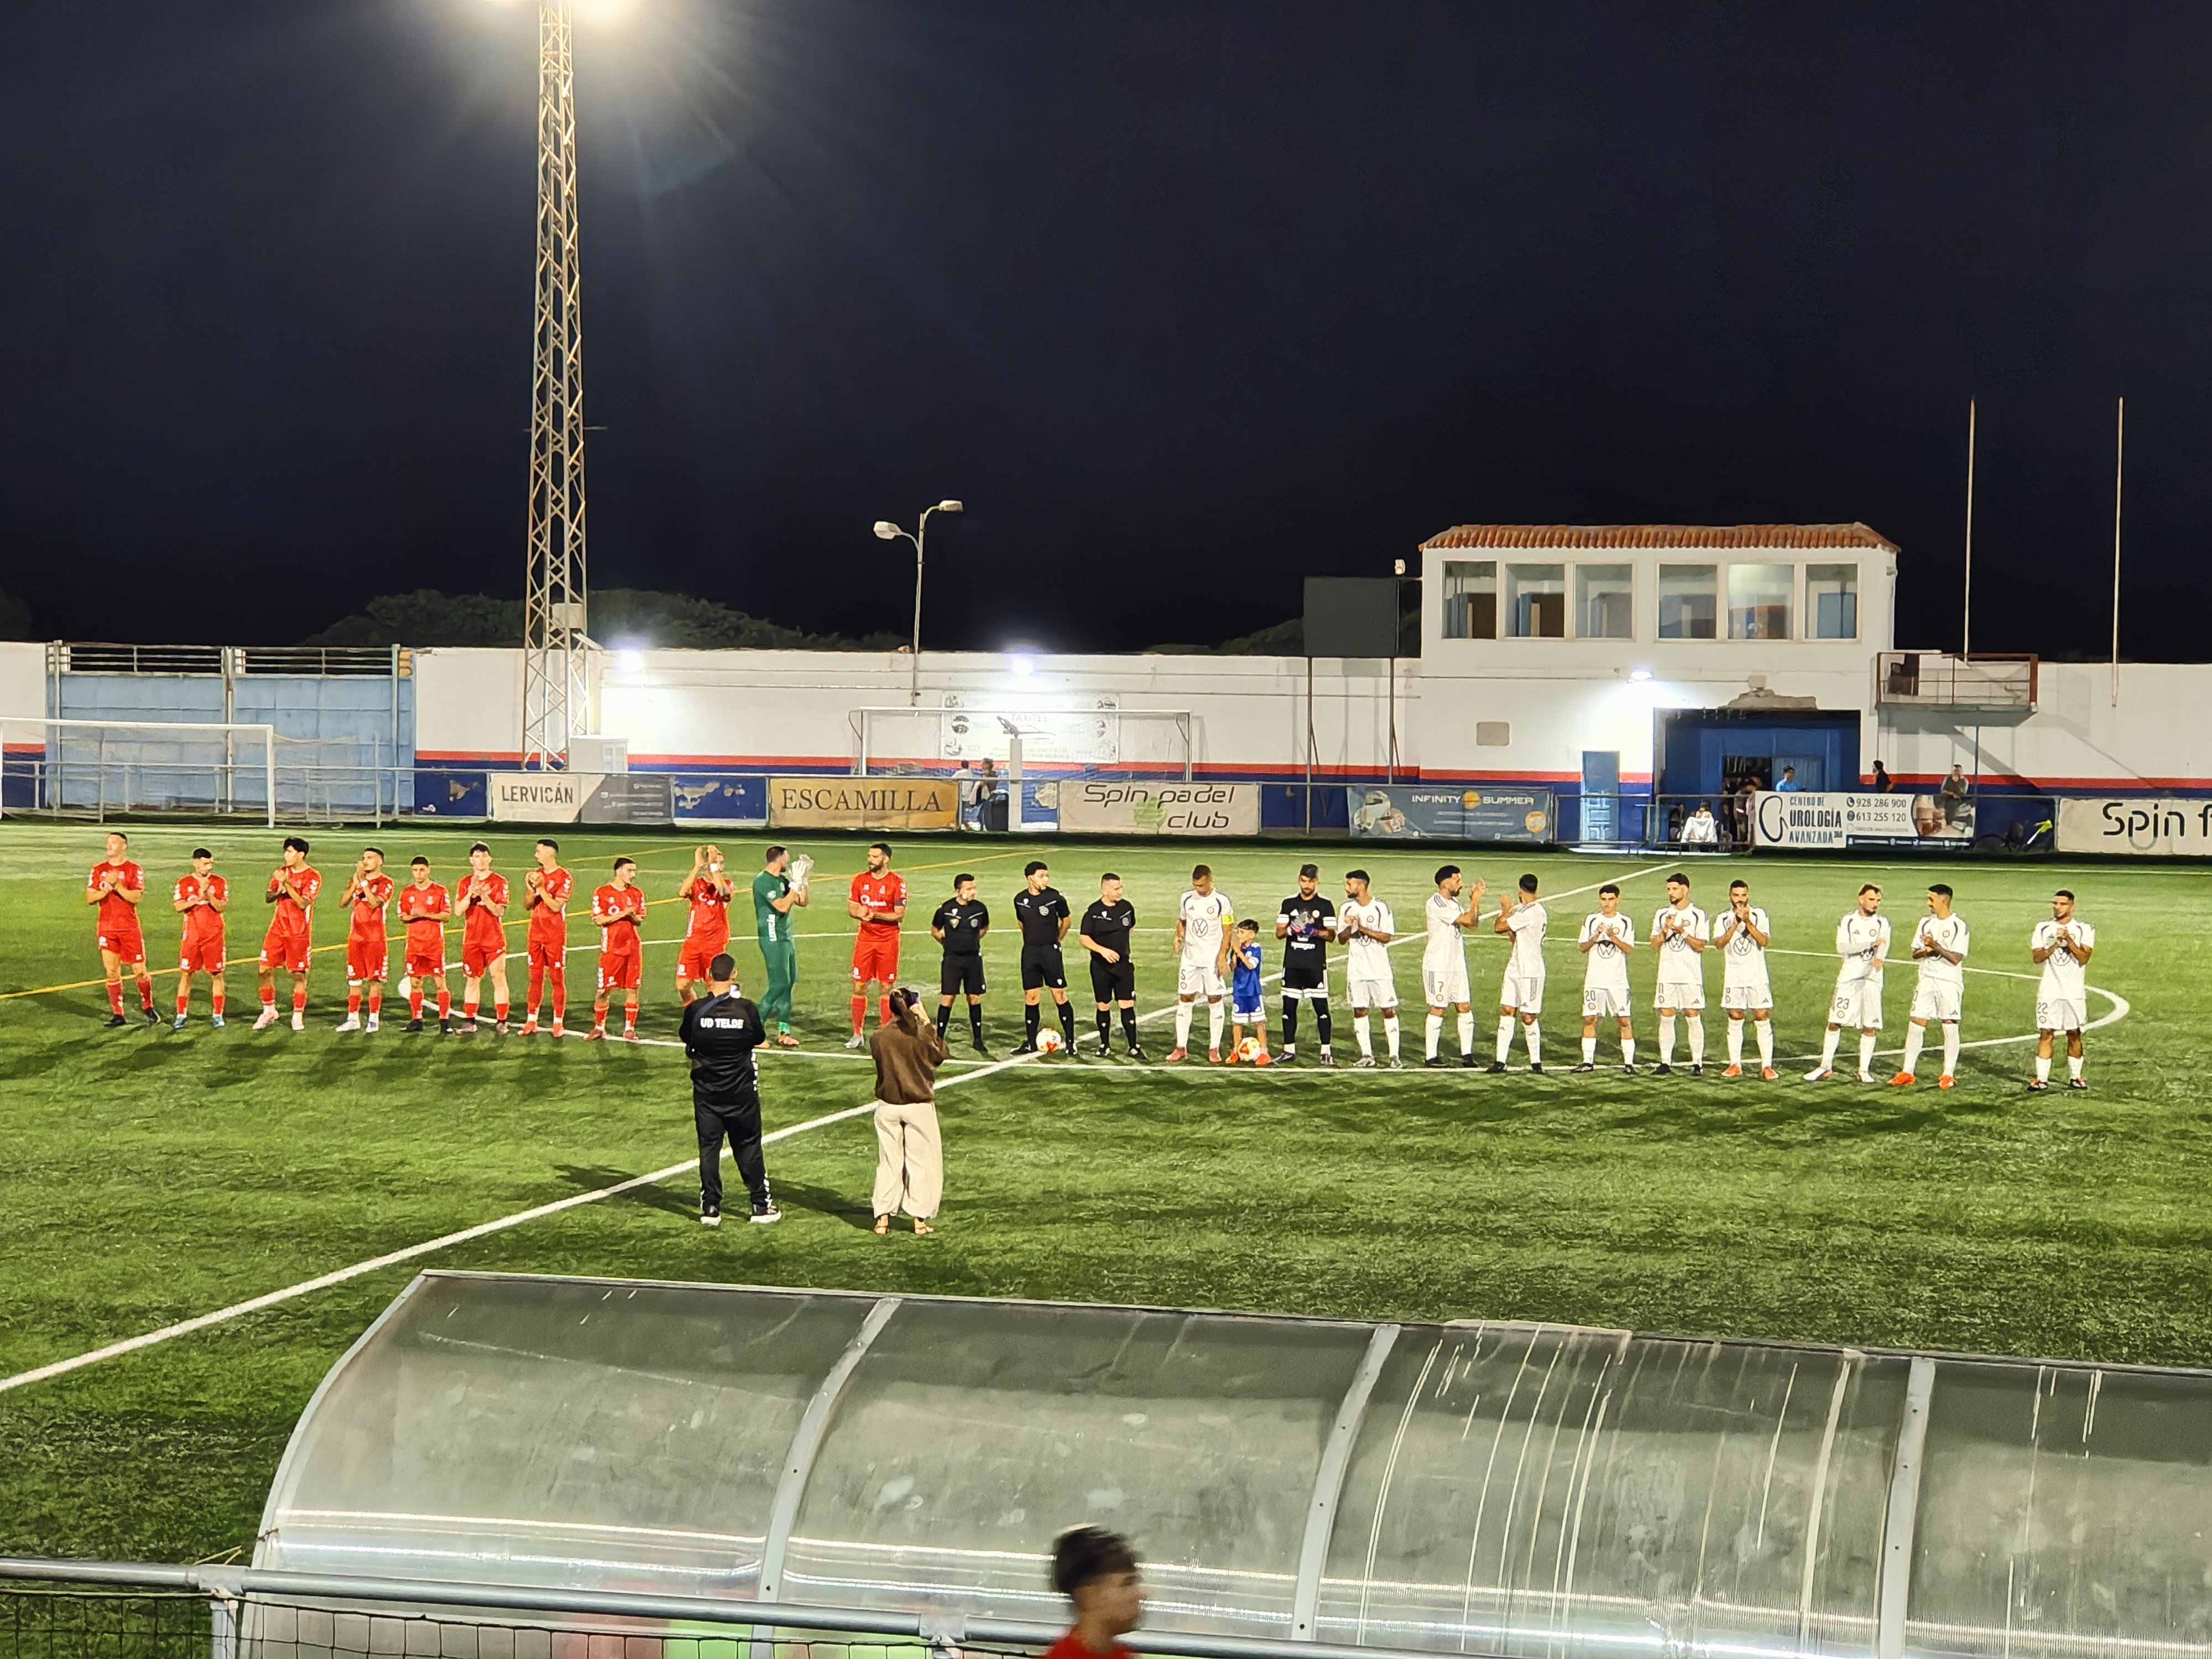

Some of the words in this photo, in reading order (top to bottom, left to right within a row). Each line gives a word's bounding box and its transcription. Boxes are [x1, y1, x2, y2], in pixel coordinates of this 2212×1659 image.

[1011, 713, 1049, 722] TAXITEL
[501, 776, 573, 804] LERVICÁN
[781, 788, 941, 812] ESCAMILLA
[1083, 784, 1148, 808] Spin
[1156, 785, 1234, 810] padel
[1411, 794, 1462, 804] INFINITY
[1482, 795, 1535, 805] SUMMER
[1790, 796, 1815, 806] CENTRO
[1817, 797, 1825, 806] DE
[1856, 798, 1872, 807] 928
[1874, 799, 1889, 808] 286
[1891, 799, 1907, 808] 900
[1167, 811, 1229, 828] club
[1856, 812, 1871, 822] 613
[1873, 812, 1888, 822] 255
[1892, 813, 1907, 822] 120
[2103, 802, 2185, 846] Spin
[1789, 831, 1834, 844] AVANZADA
[1438, 980, 1444, 993] 7
[1585, 989, 1597, 1002] 20
[1836, 997, 1850, 1010] 23
[700, 1017, 714, 1029] UD
[714, 1018, 744, 1030] TELDE
